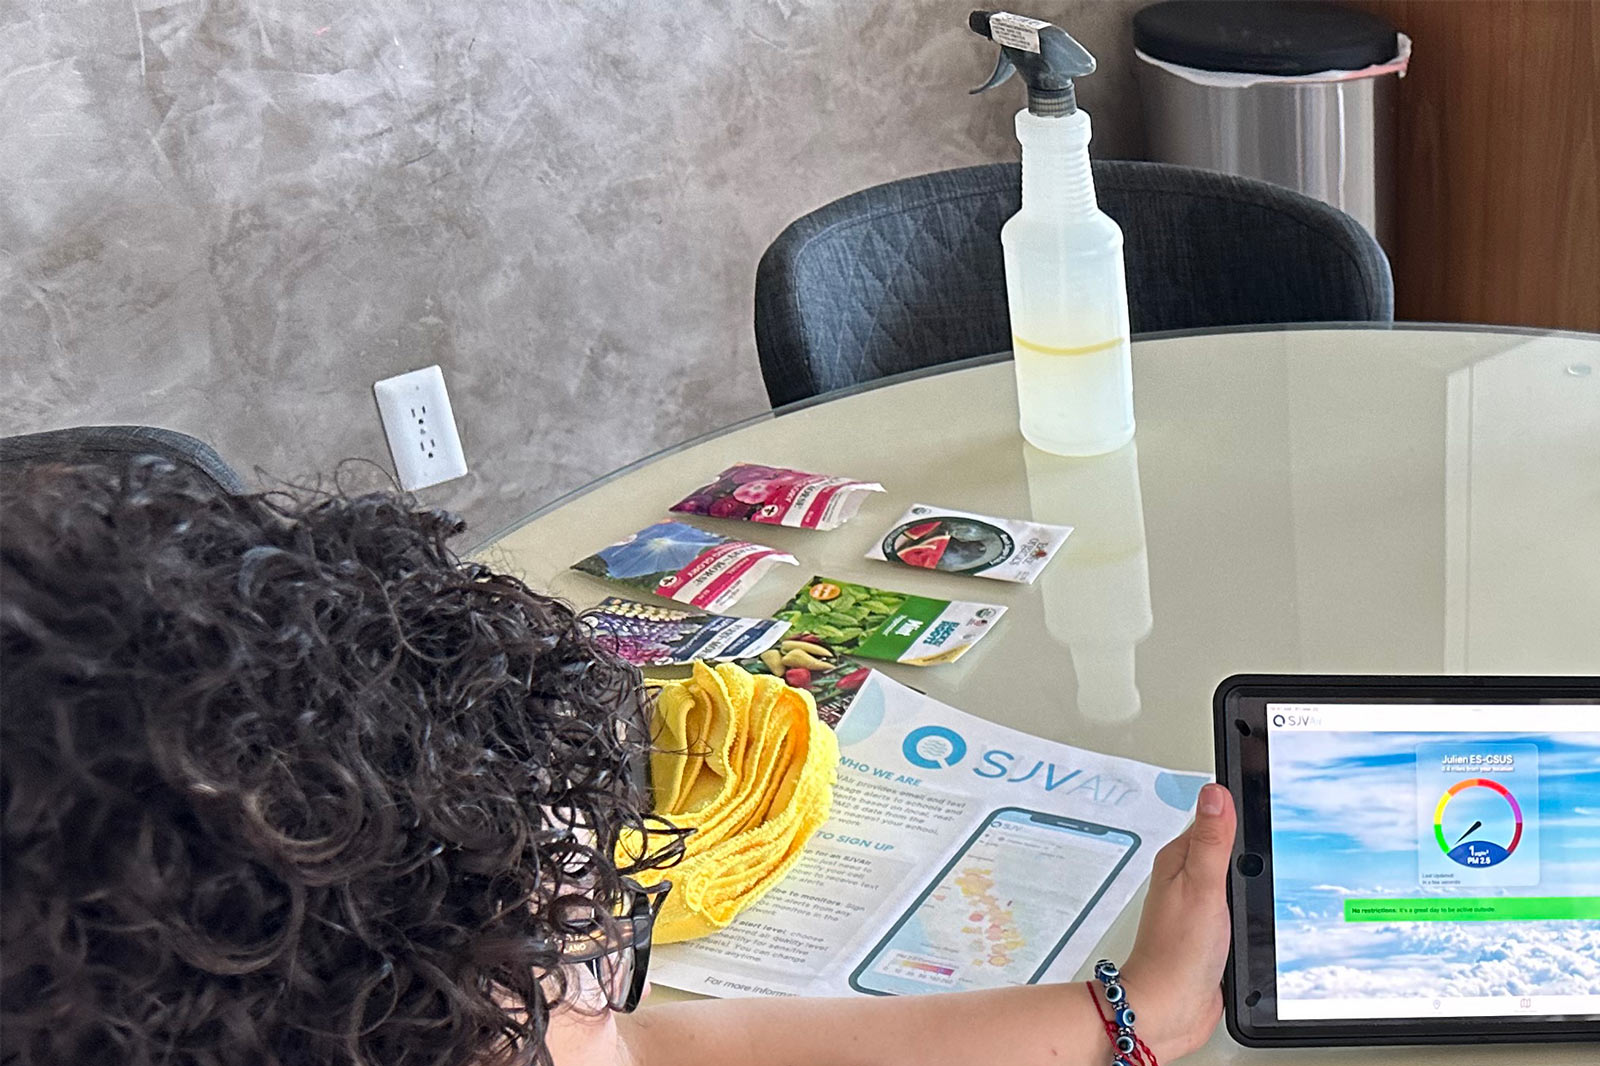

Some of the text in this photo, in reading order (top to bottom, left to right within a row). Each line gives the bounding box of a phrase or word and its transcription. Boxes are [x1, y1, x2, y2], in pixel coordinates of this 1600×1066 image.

[1442, 754, 1468, 764] Julien
[872, 768, 894, 780] WE
[896, 775, 923, 786] ARE
[973, 749, 1138, 804] SJVAir
[856, 779, 897, 794] provides
[900, 788, 925, 800] email
[927, 796, 946, 804] and
[946, 799, 966, 809] text
[859, 799, 888, 809] based
[864, 791, 890, 801] alerts
[906, 800, 942, 812] schools
[945, 808, 963, 816] and
[844, 810, 880, 822] nearest
[881, 819, 903, 827] your
[861, 806, 882, 815] data
[885, 811, 907, 820] from
[816, 830, 895, 851] TO SIGN UP
[860, 882, 879, 890] text
[812, 902, 834, 913] from
[834, 910, 851, 918] any
[823, 914, 839, 922] the
[739, 919, 762, 930] alert
[806, 942, 829, 951] level
[705, 976, 723, 987] For
[723, 981, 751, 992] more
